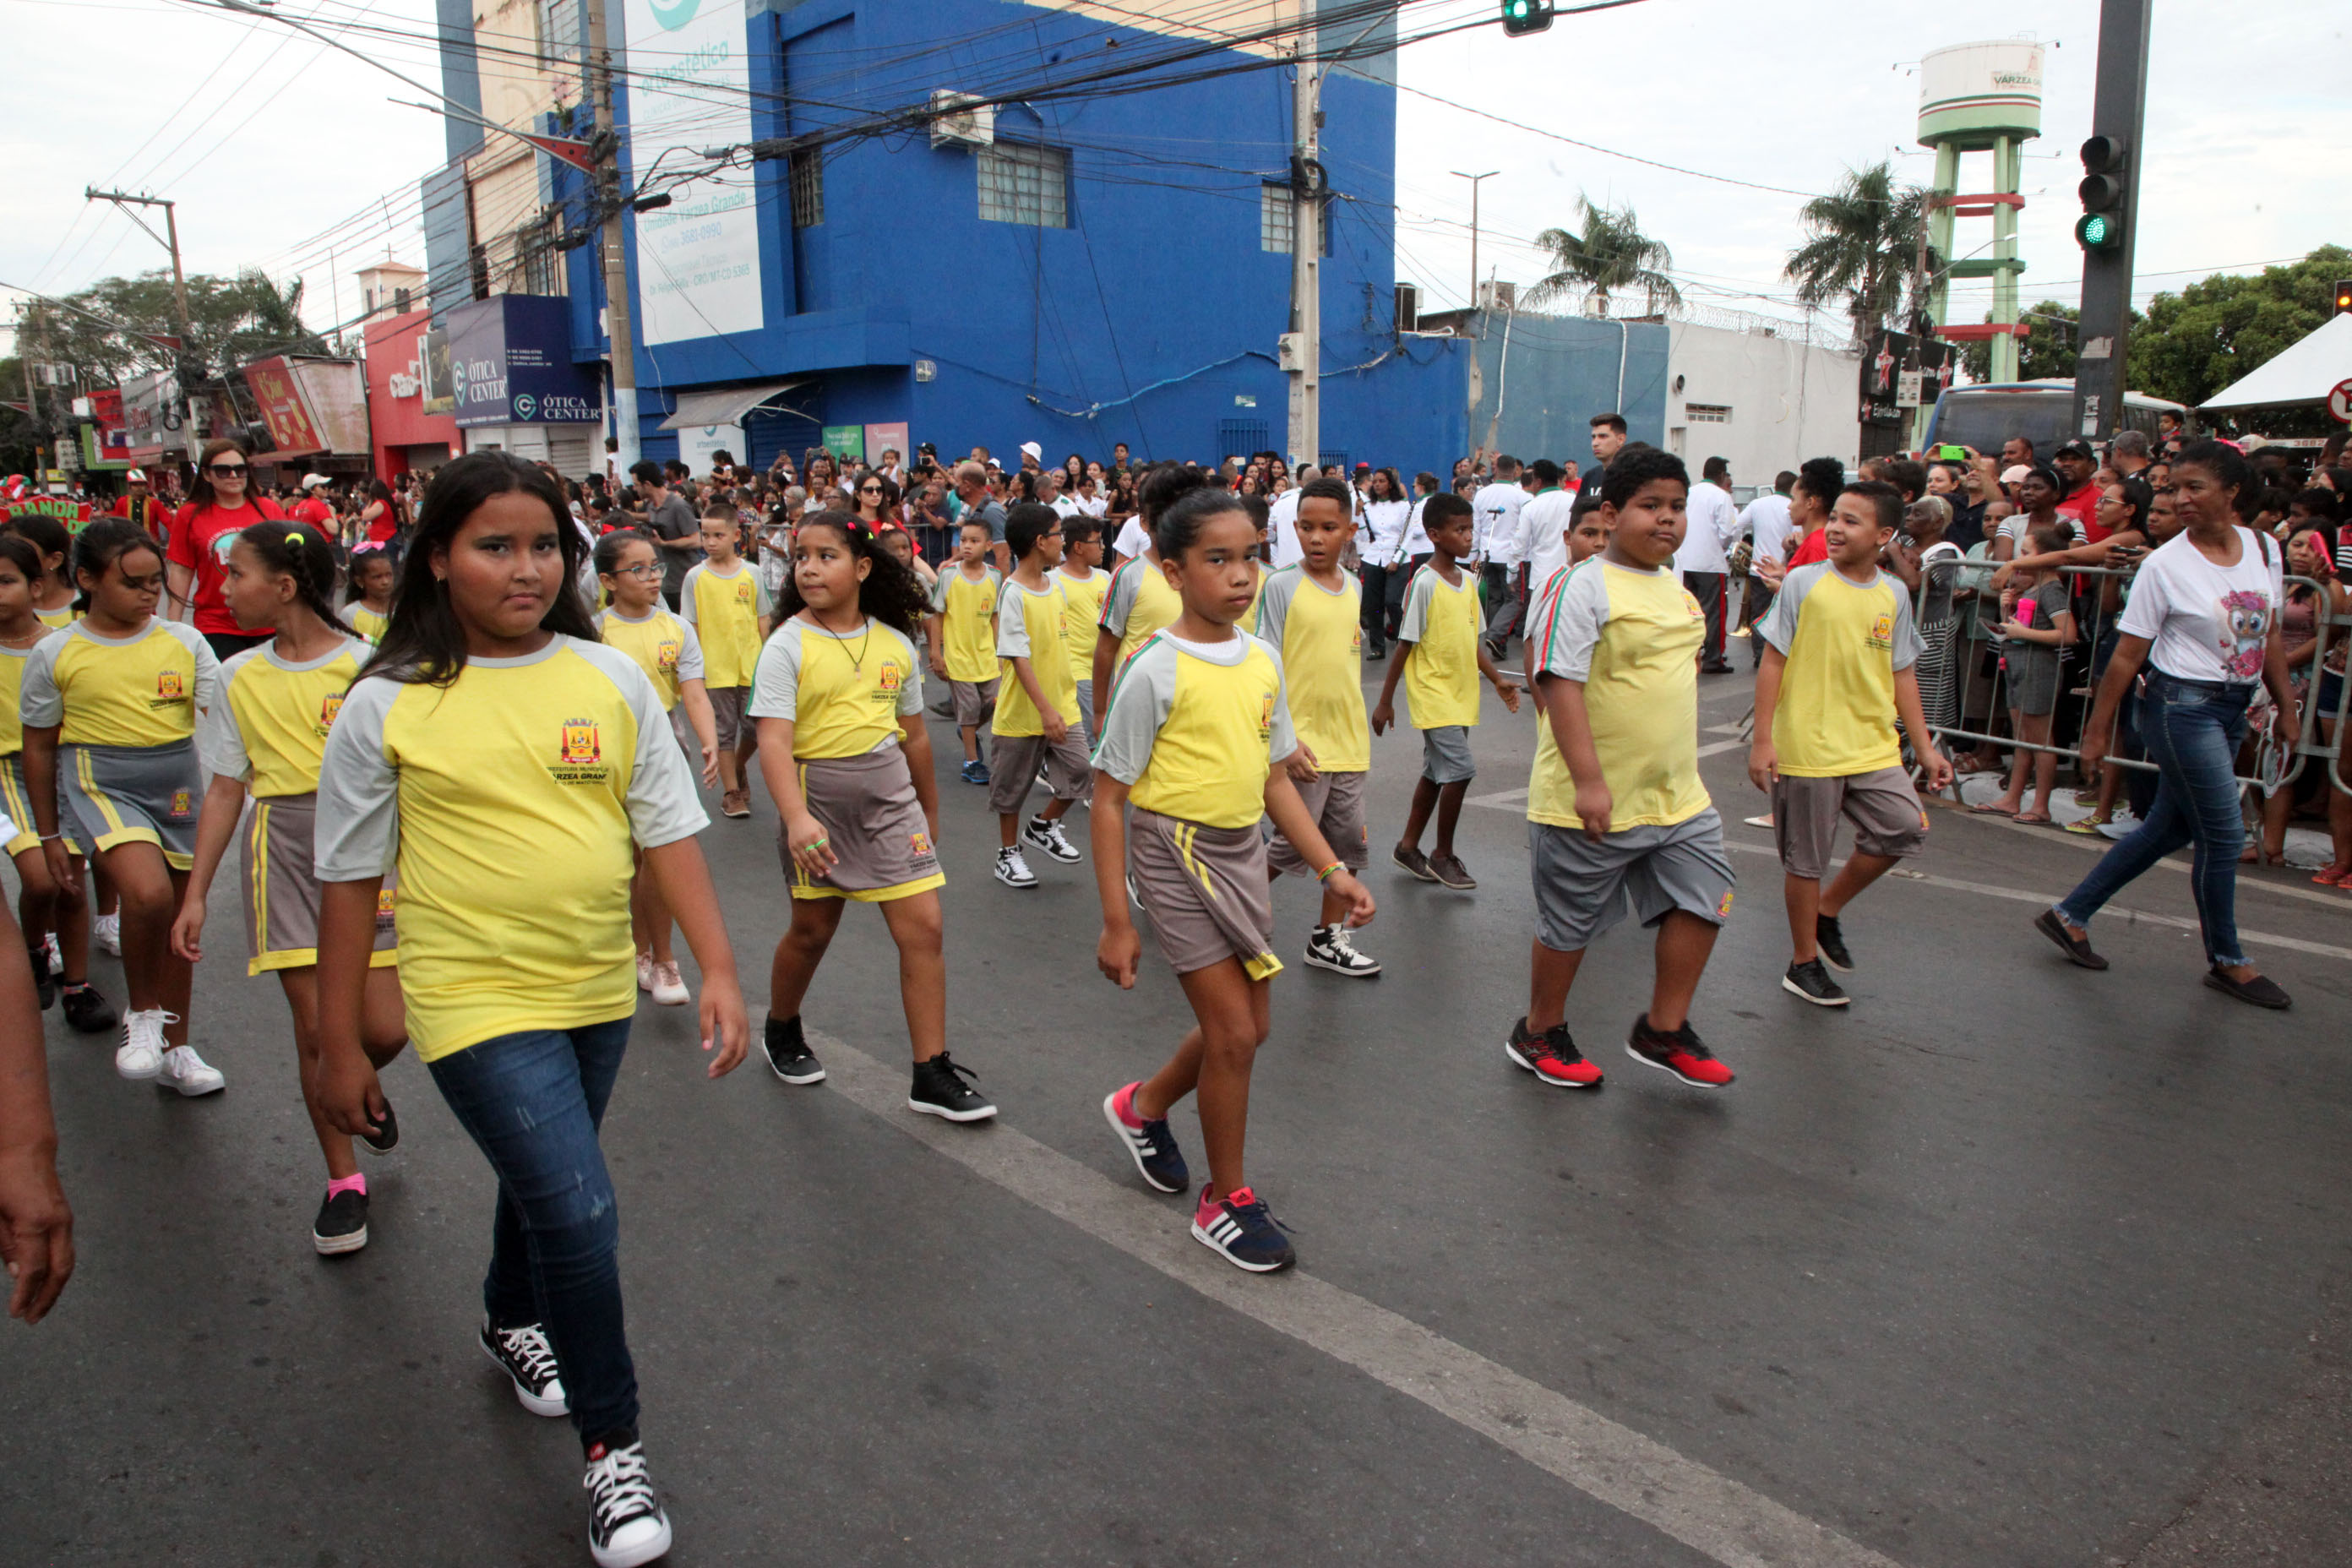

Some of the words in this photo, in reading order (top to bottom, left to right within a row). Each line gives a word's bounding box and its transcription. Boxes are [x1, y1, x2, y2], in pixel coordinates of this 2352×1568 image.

[711, 188, 747, 213] Grande
[469, 358, 498, 383] ÓTICA
[471, 380, 507, 403] CENTER
[543, 393, 588, 408] ÓTICA
[543, 407, 600, 420] CENTER
[8, 499, 79, 519] BANDA
